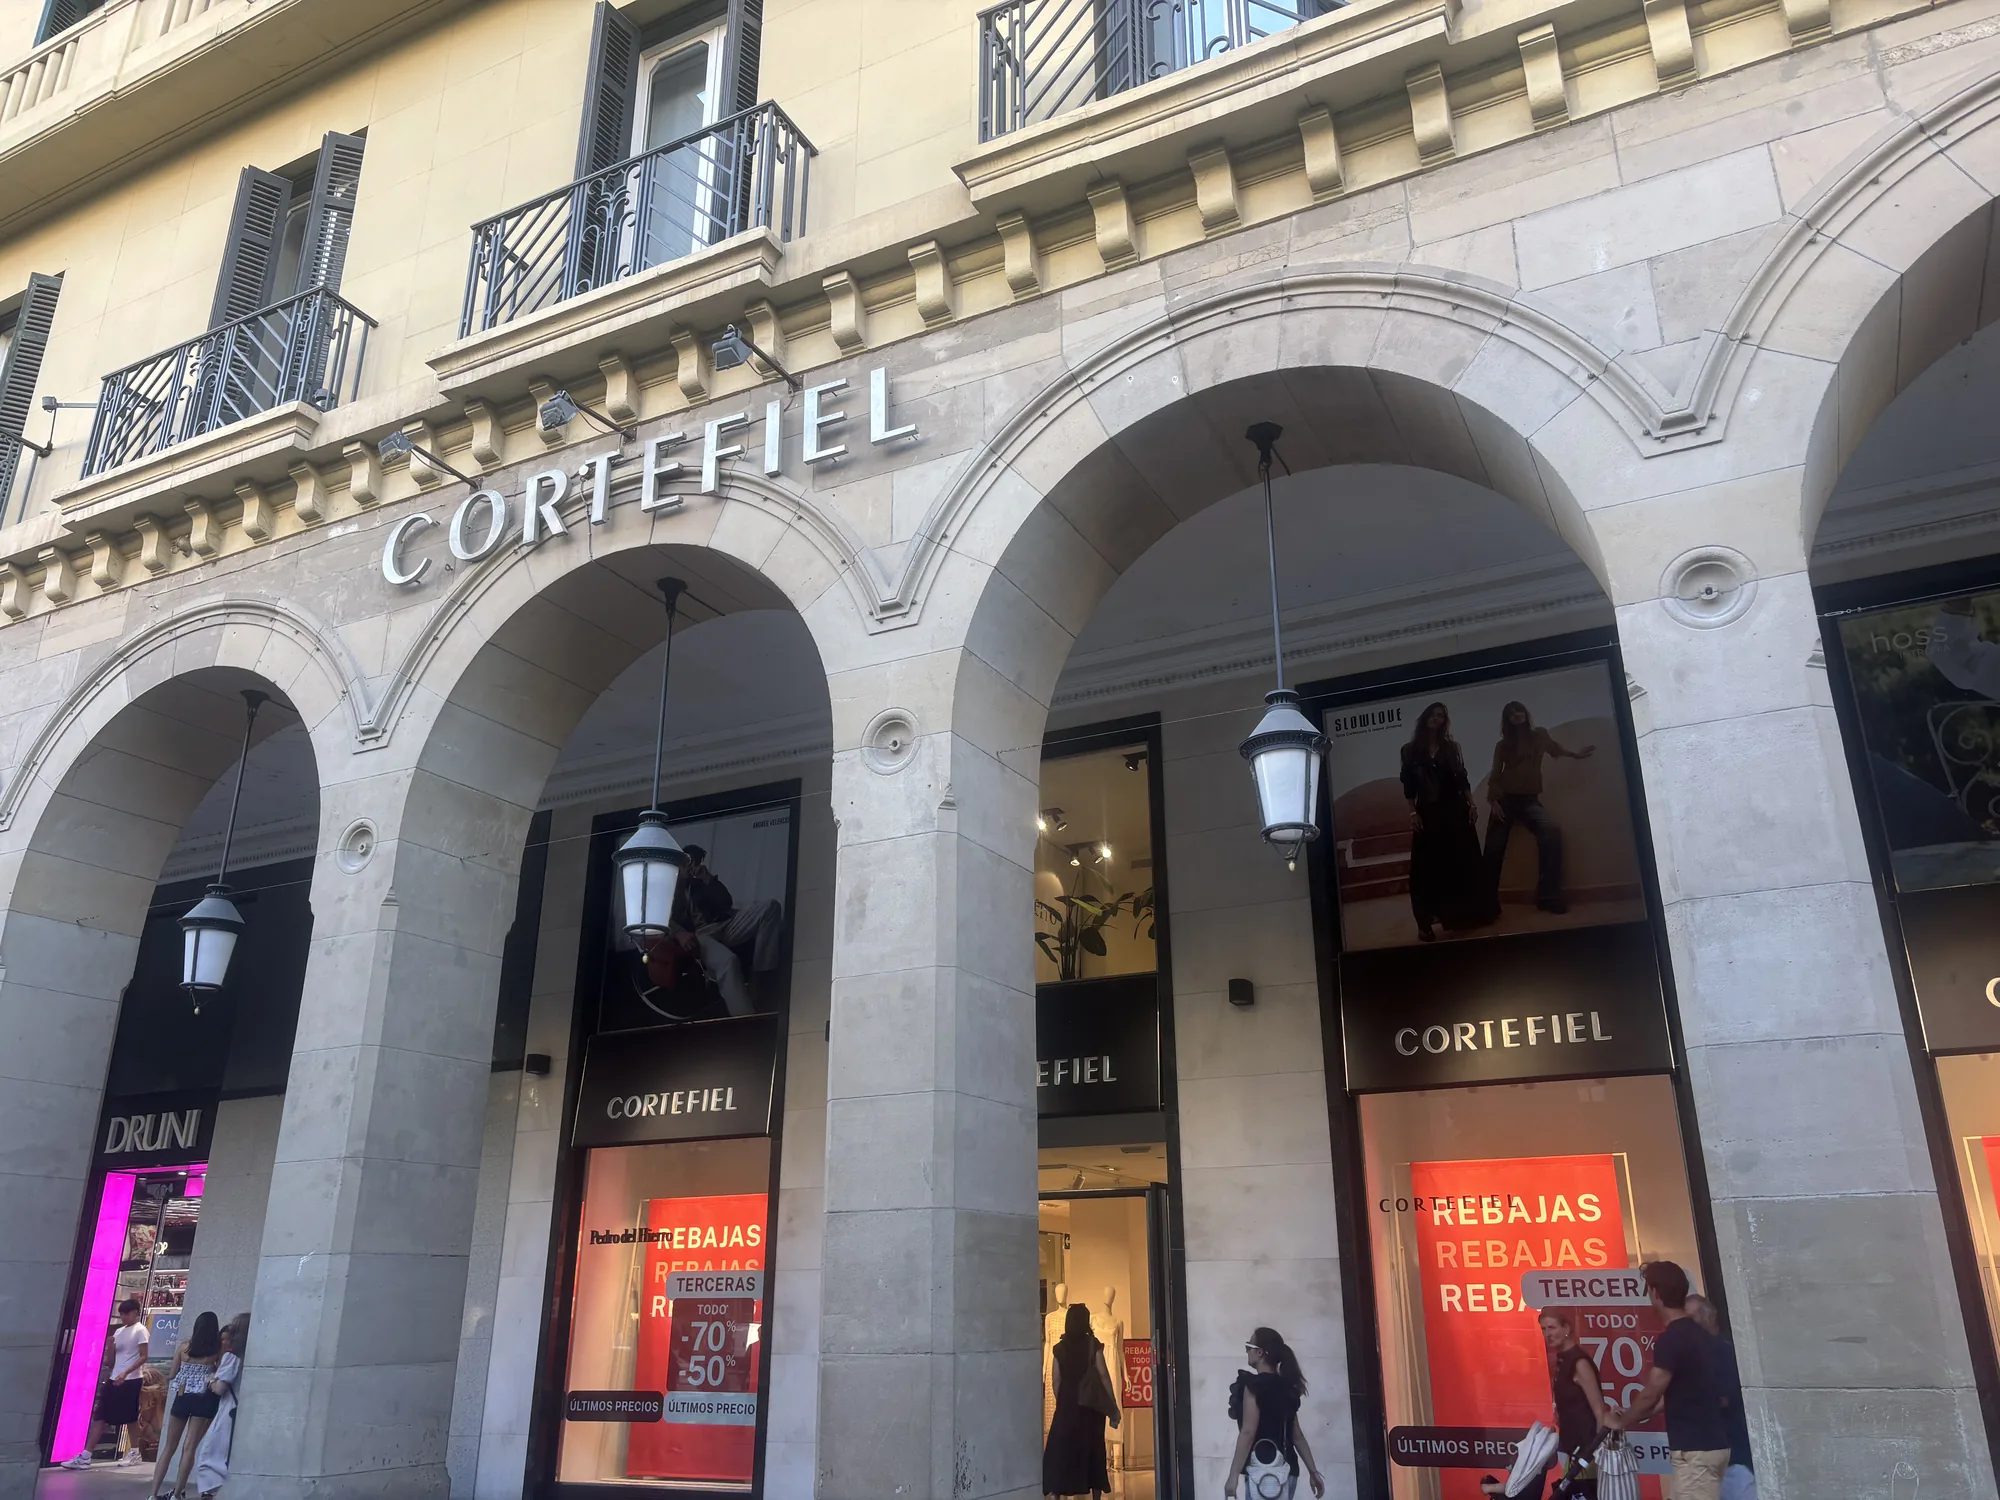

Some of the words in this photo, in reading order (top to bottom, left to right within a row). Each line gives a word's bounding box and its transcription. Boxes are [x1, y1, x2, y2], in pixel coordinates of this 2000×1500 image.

[383, 367, 919, 585] CORTEFIEL
[1870, 626, 1948, 653] hoss
[1394, 1011, 1612, 1056] CORTEFIEL
[606, 1086, 738, 1120] CORTEFIEL
[104, 1109, 202, 1154] DRUNI
[1379, 1193, 1518, 1213] CORTEFIEL
[1432, 1193, 1602, 1226] REBAJAS
[590, 1229, 620, 1245] Pedro
[657, 1224, 762, 1250] REBAJAS
[1436, 1237, 1608, 1269] REBAJAS
[676, 1276, 756, 1293] TERCERAS
[570, 1398, 613, 1412] ÚLTIMOS
[615, 1401, 659, 1413] PRECIOS
[668, 1399, 714, 1414] ÚLTIMOS
[1397, 1436, 1470, 1455] ÚLTIMOS
